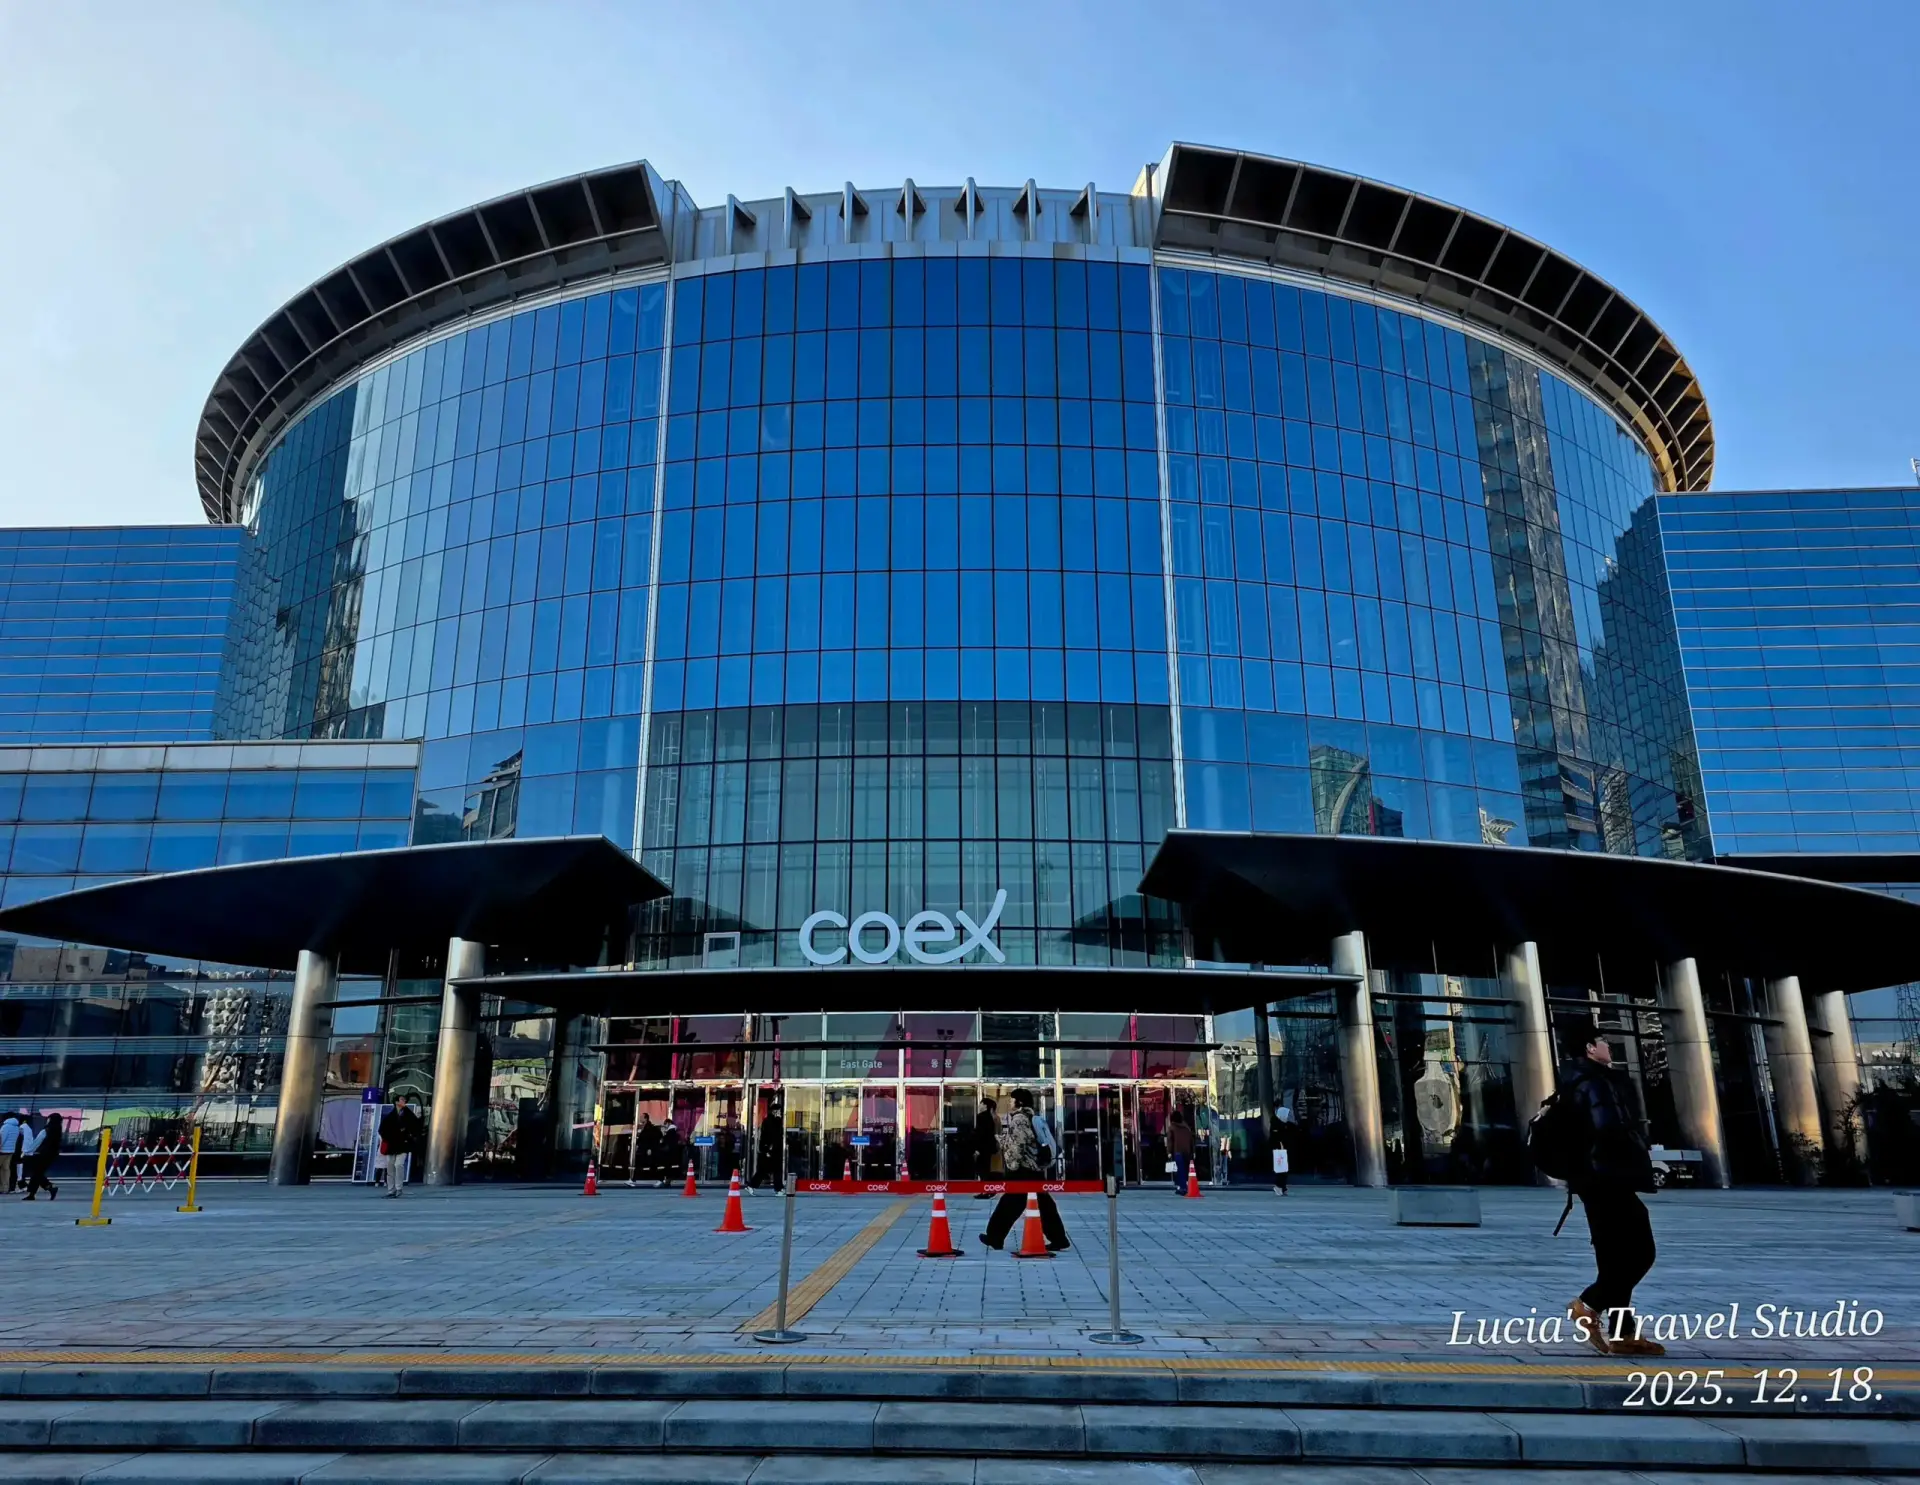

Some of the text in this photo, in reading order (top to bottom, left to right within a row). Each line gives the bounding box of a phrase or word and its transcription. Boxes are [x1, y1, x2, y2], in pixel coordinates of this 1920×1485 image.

[799, 888, 1008, 965] coex
[840, 1059, 883, 1069] East Gate
[809, 1181, 1065, 1192] coex coex coex coex coex
